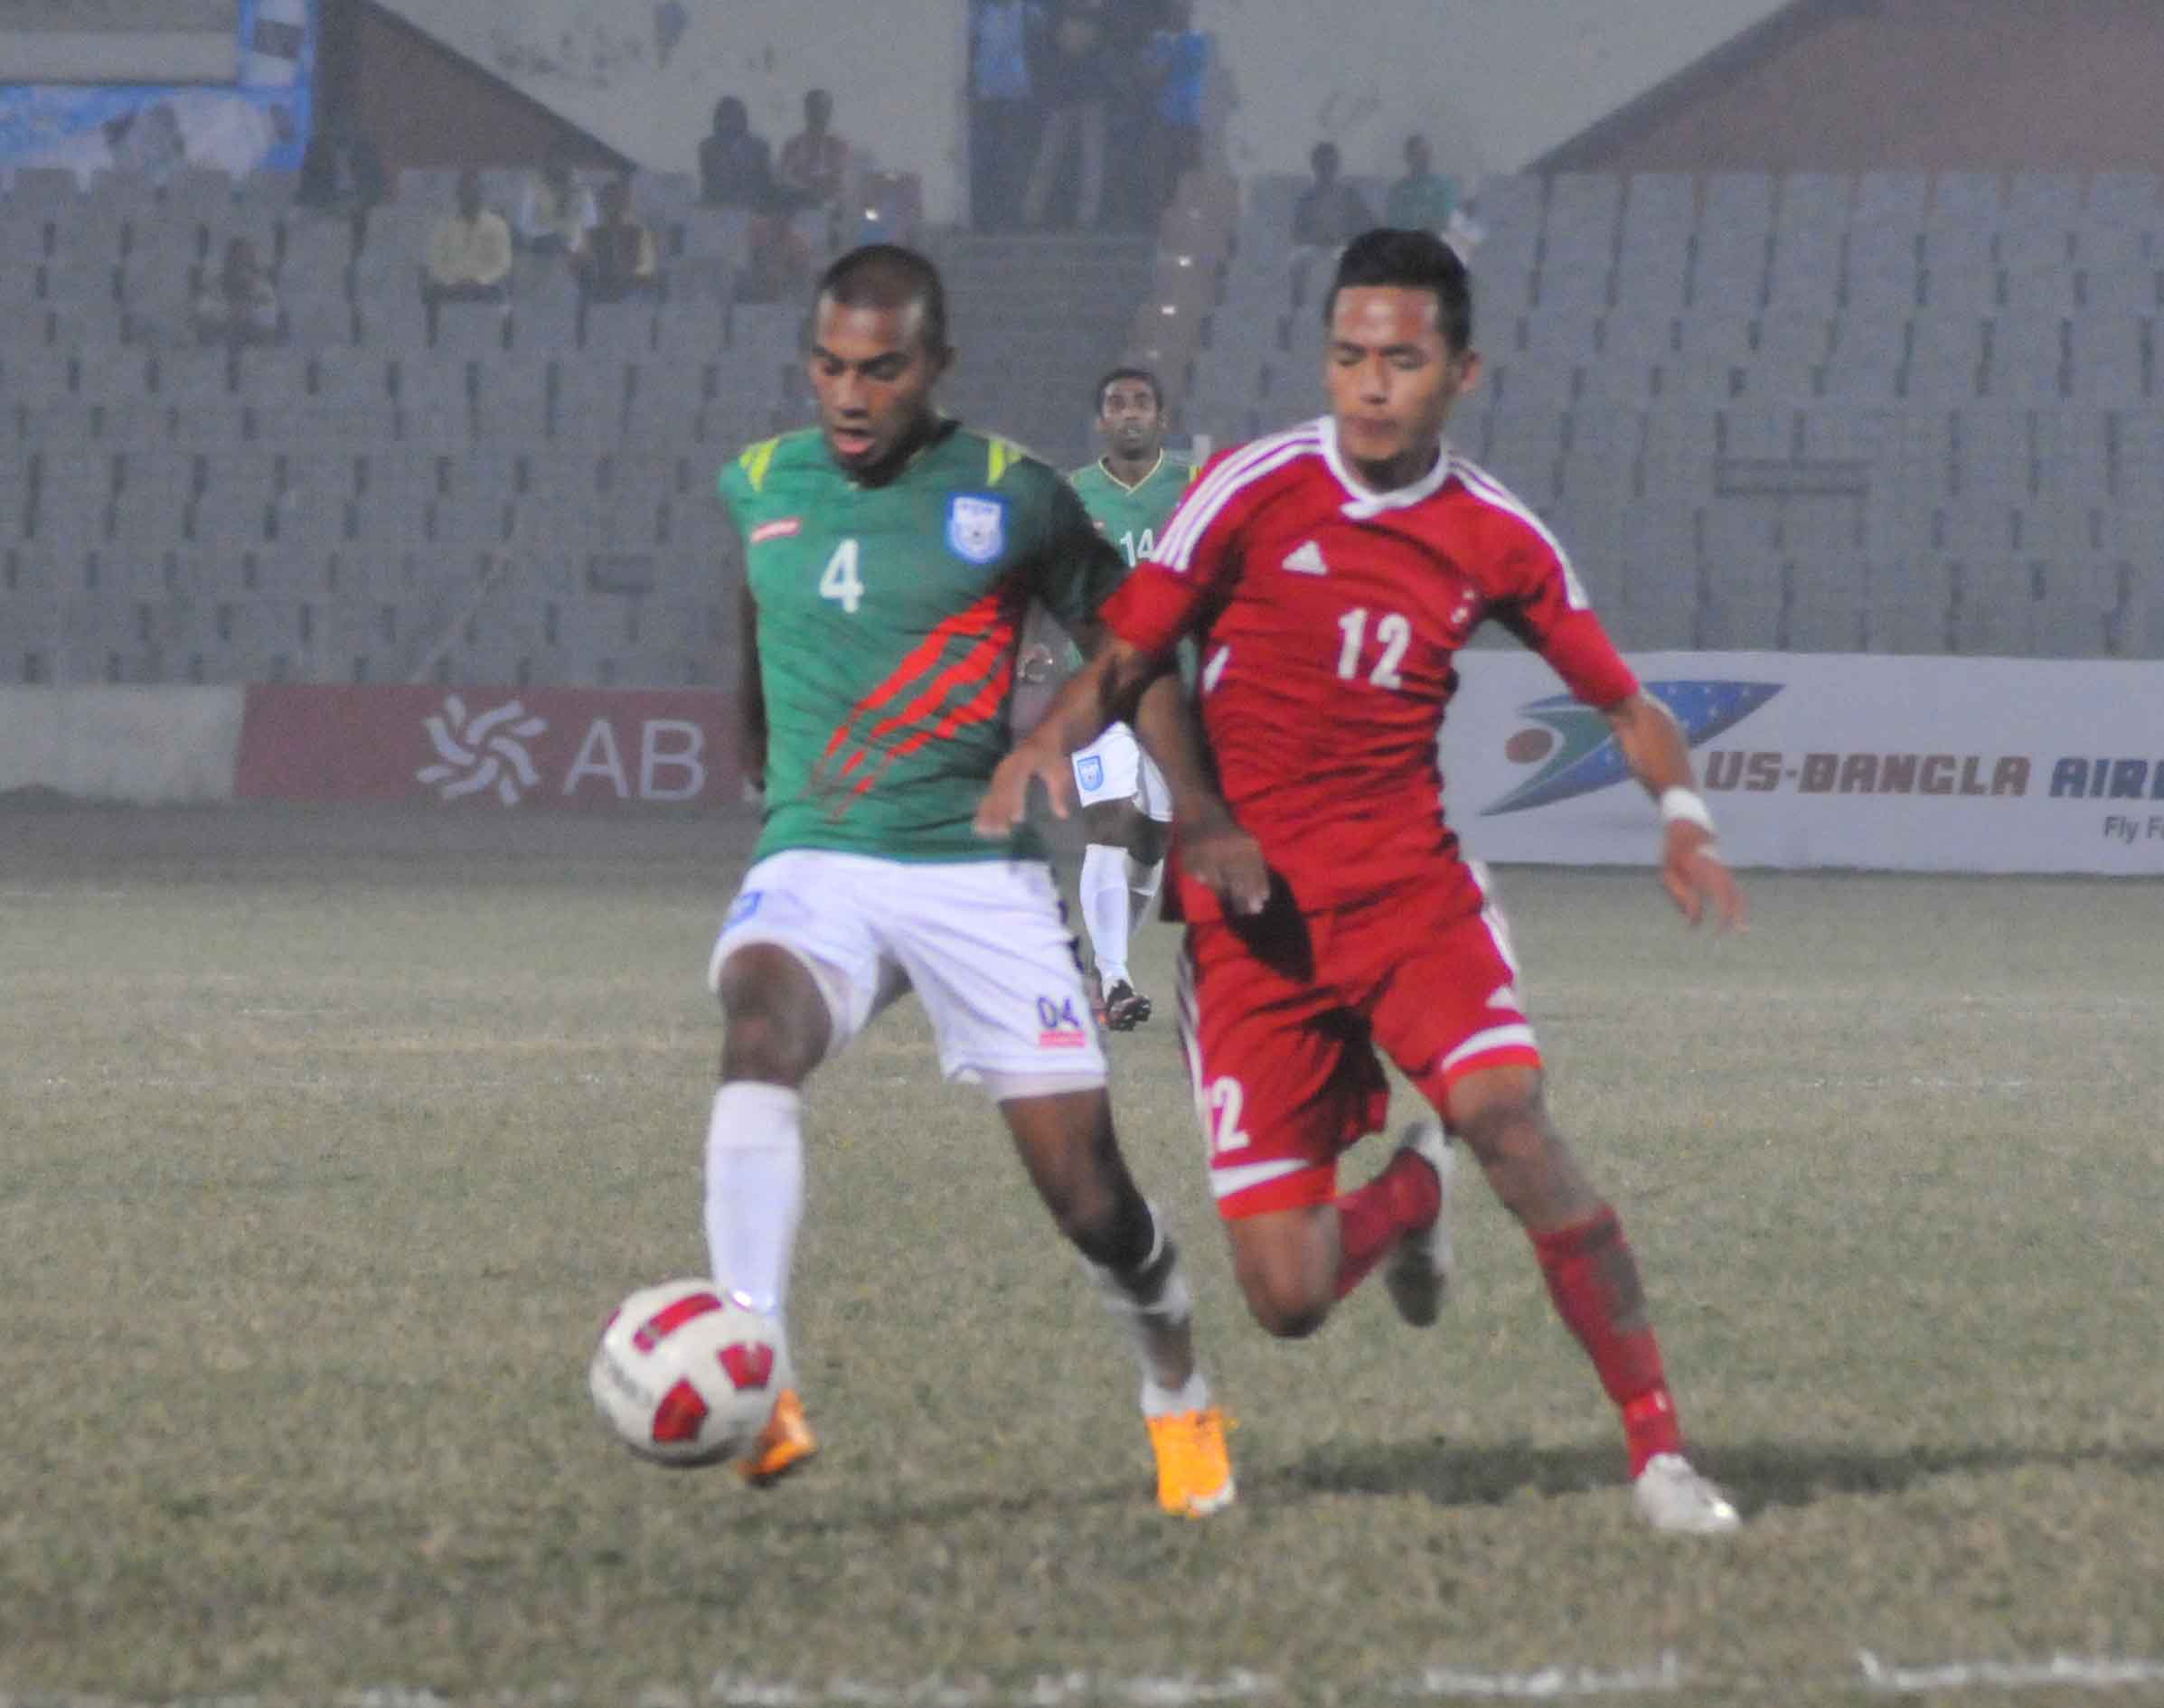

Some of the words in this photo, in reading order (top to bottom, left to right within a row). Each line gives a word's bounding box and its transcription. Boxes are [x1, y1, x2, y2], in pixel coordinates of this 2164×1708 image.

[820, 540, 864, 613] 4
[1120, 529, 1154, 568] 14
[1338, 607, 1412, 690] 12
[562, 718, 707, 801] AB
[1703, 751, 2031, 797] US-BANGLA
[2103, 816, 2140, 845] Fly
